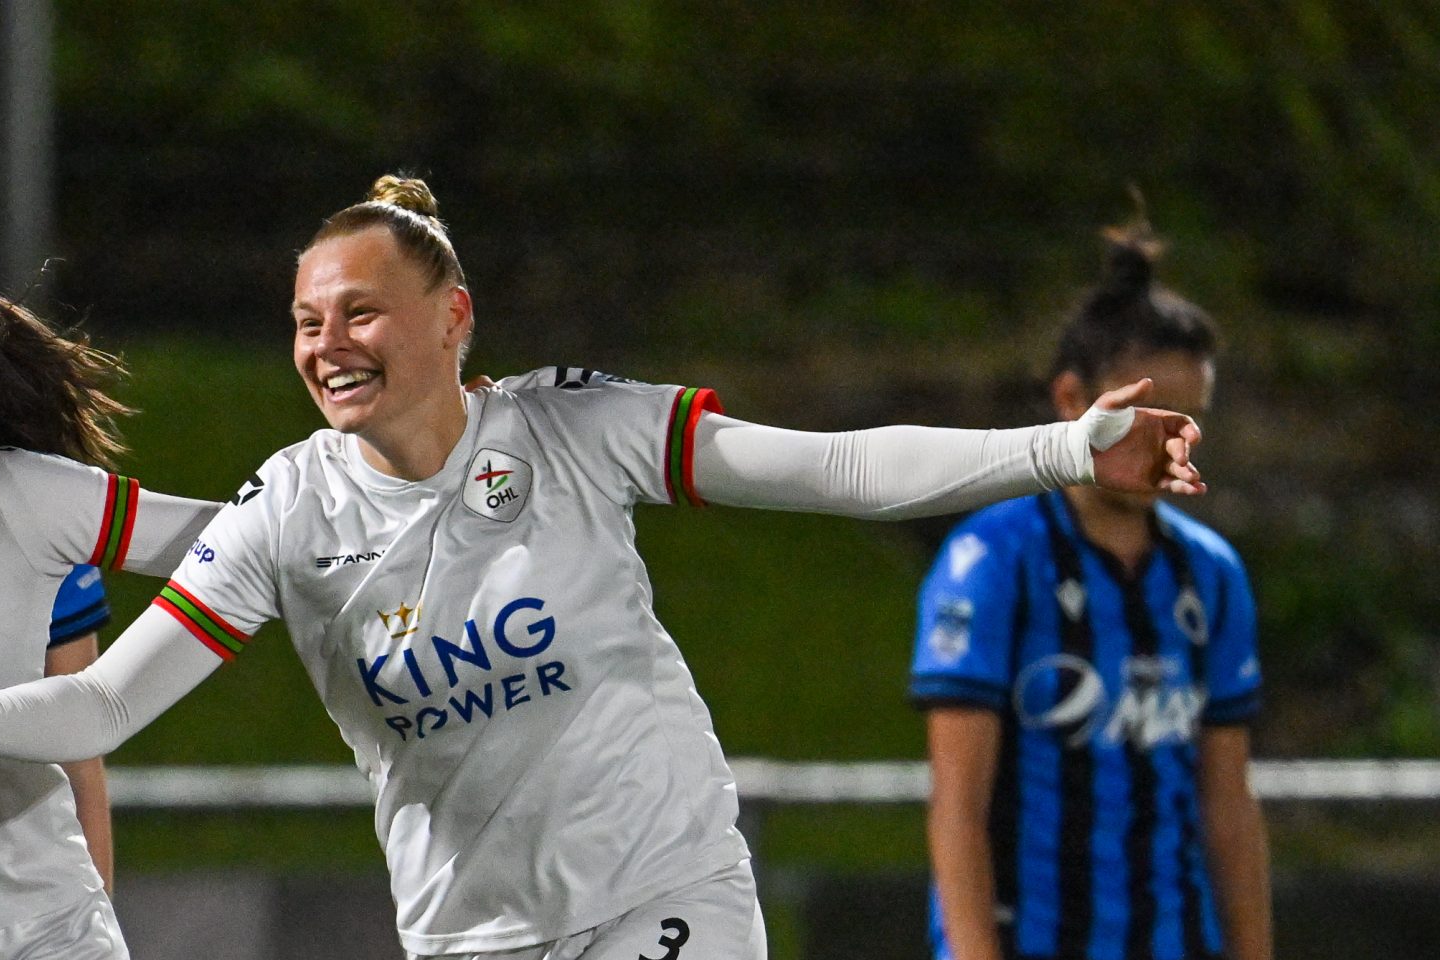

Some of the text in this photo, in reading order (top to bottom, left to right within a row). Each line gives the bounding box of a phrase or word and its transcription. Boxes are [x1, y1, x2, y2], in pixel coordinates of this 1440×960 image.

[487, 487, 519, 508] OHL
[316, 550, 385, 568] STANN
[357, 597, 555, 706] KING
[386, 661, 572, 741] POWER
